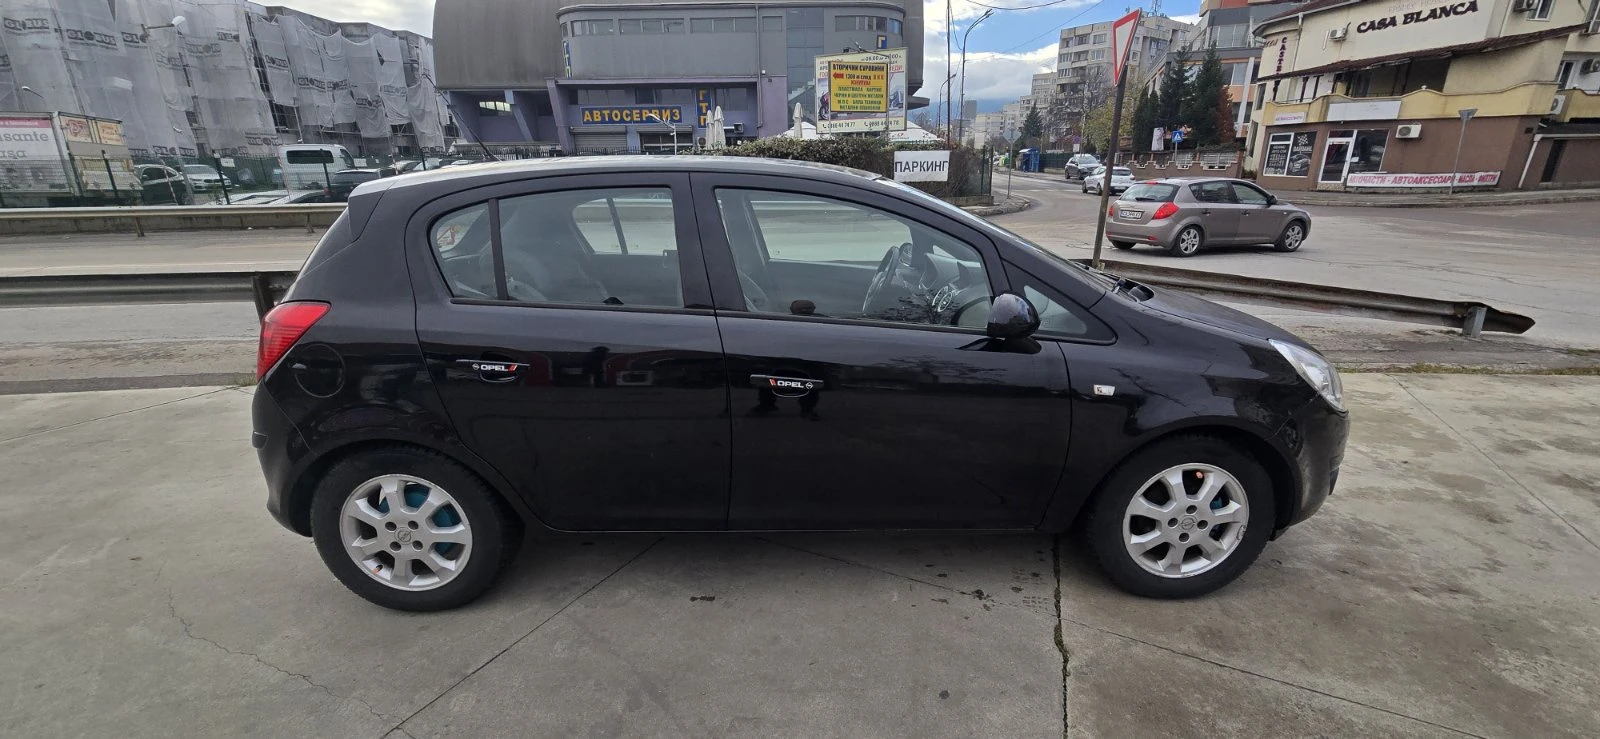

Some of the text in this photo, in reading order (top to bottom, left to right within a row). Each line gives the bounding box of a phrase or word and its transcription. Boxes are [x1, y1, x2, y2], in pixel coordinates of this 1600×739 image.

[1357, 0, 1479, 33] CASA BLANCA
[1276, 36, 1288, 75] CASTE
[583, 108, 681, 122] АВТОСЕРВИЗ
[0, 131, 49, 141] sante
[894, 161, 949, 173] ПАРКИНГ
[480, 364, 509, 372] OPEL
[777, 380, 804, 389] OPEL
